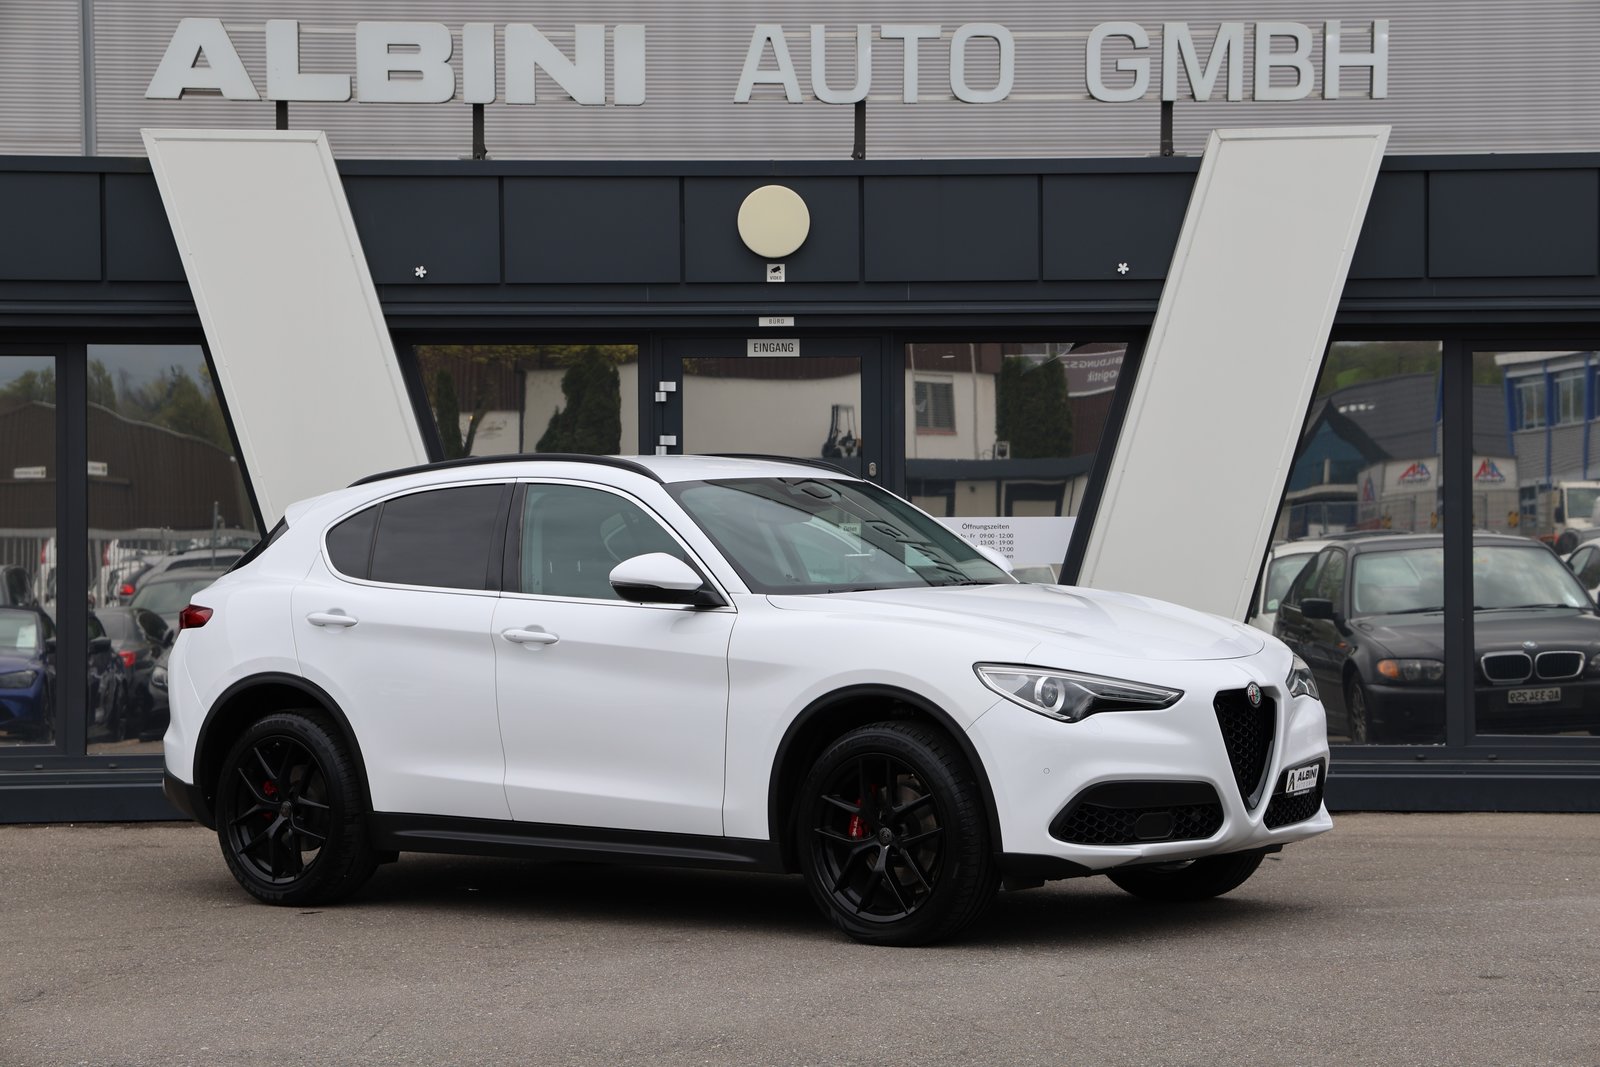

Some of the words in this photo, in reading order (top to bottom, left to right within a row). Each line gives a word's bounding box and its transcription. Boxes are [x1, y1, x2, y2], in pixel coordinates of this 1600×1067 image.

[144, 17, 646, 106] ALBINI
[733, 22, 1015, 104] AUTO
[1085, 19, 1390, 104] GMBH
[753, 342, 794, 353] EINGANG
[1297, 768, 1318, 782] ALBINI
